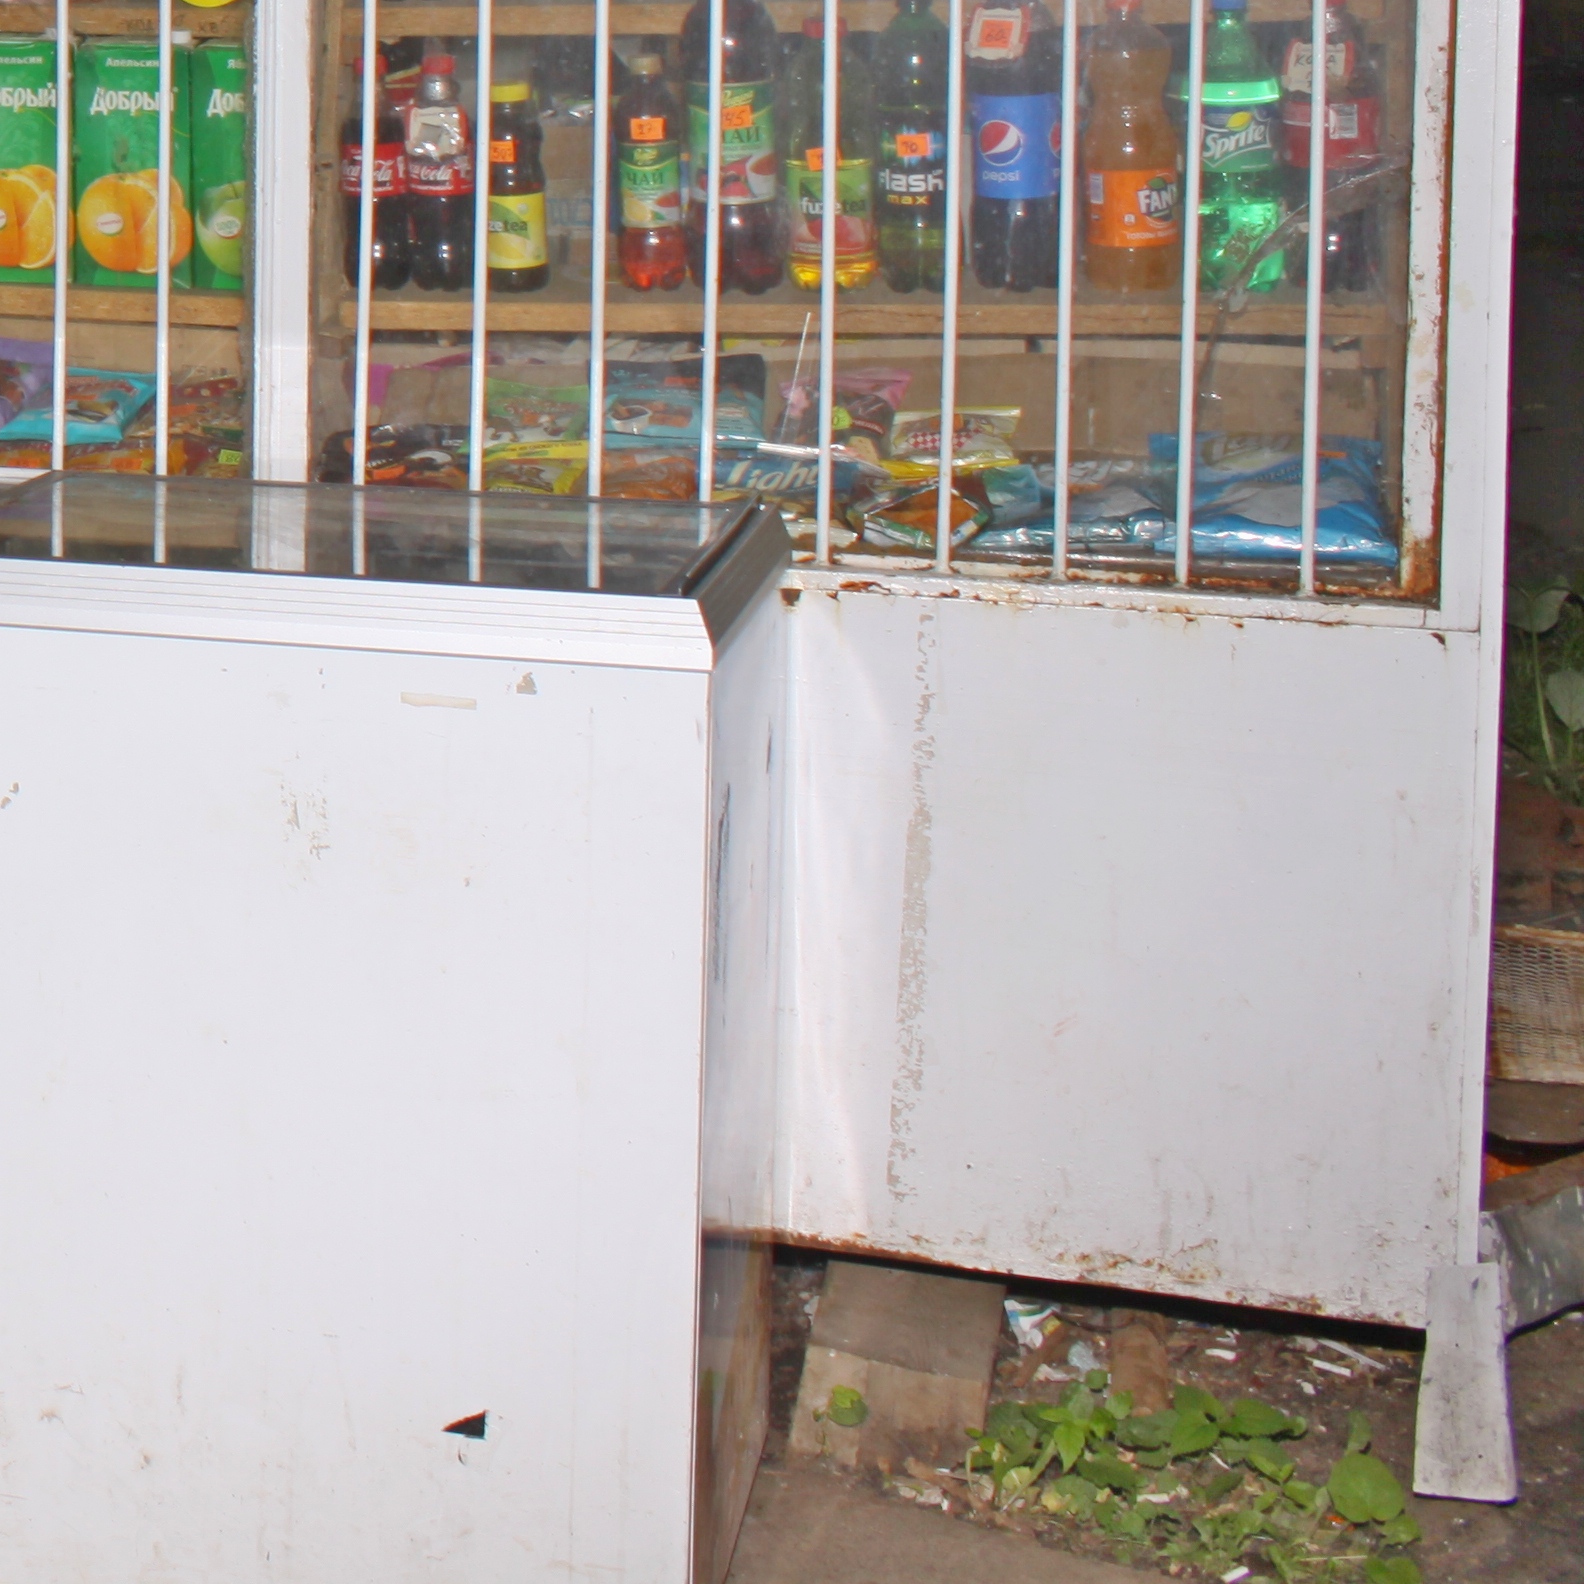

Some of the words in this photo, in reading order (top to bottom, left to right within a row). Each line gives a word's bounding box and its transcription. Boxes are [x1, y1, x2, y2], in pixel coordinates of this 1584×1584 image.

[90, 86, 175, 116] Добры
[207, 88, 244, 118] Доб
[1203, 124, 1266, 158] Sprite
[982, 170, 1020, 184] pepsi
[886, 193, 928, 205] max
